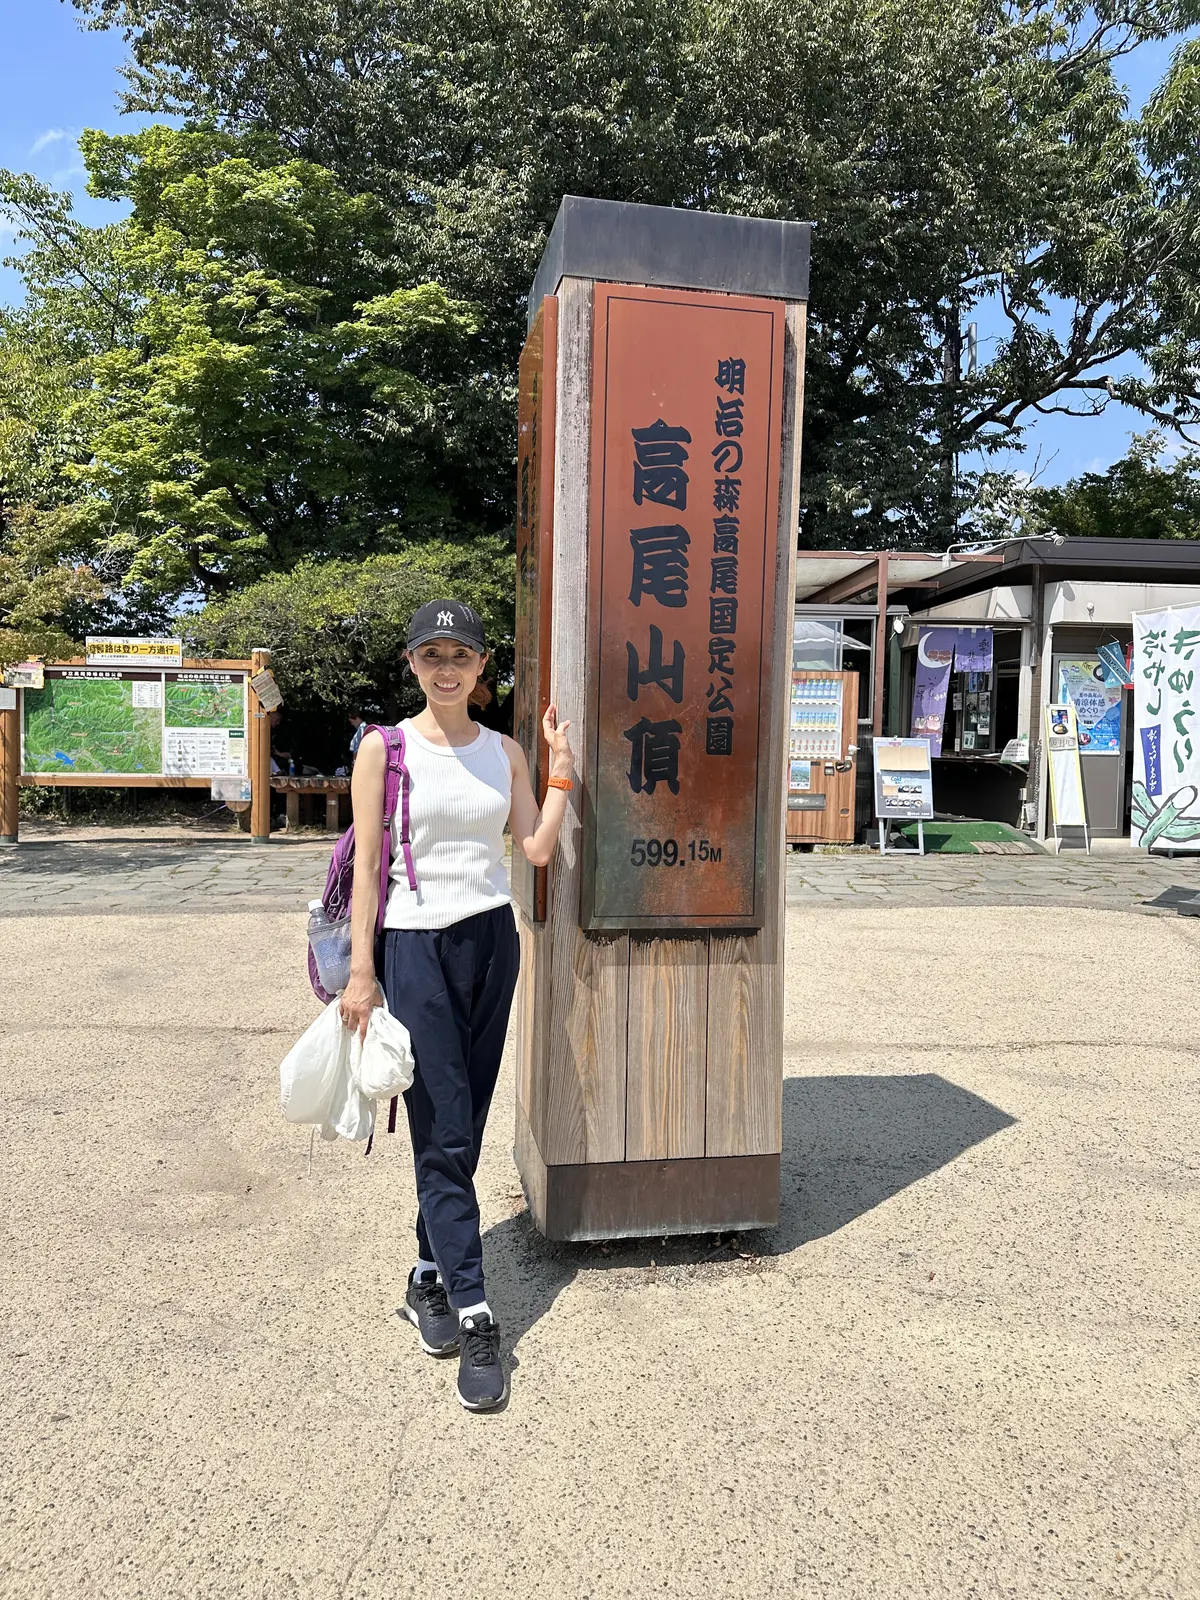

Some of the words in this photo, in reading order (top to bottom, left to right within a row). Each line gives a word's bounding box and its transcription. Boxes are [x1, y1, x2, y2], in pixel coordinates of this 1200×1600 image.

[436, 610, 454, 627] NY
[623, 417, 692, 796] 高尾山頂
[705, 356, 747, 756] 明治の森高尾国定公園
[1079, 706, 1099, 714] めぐり
